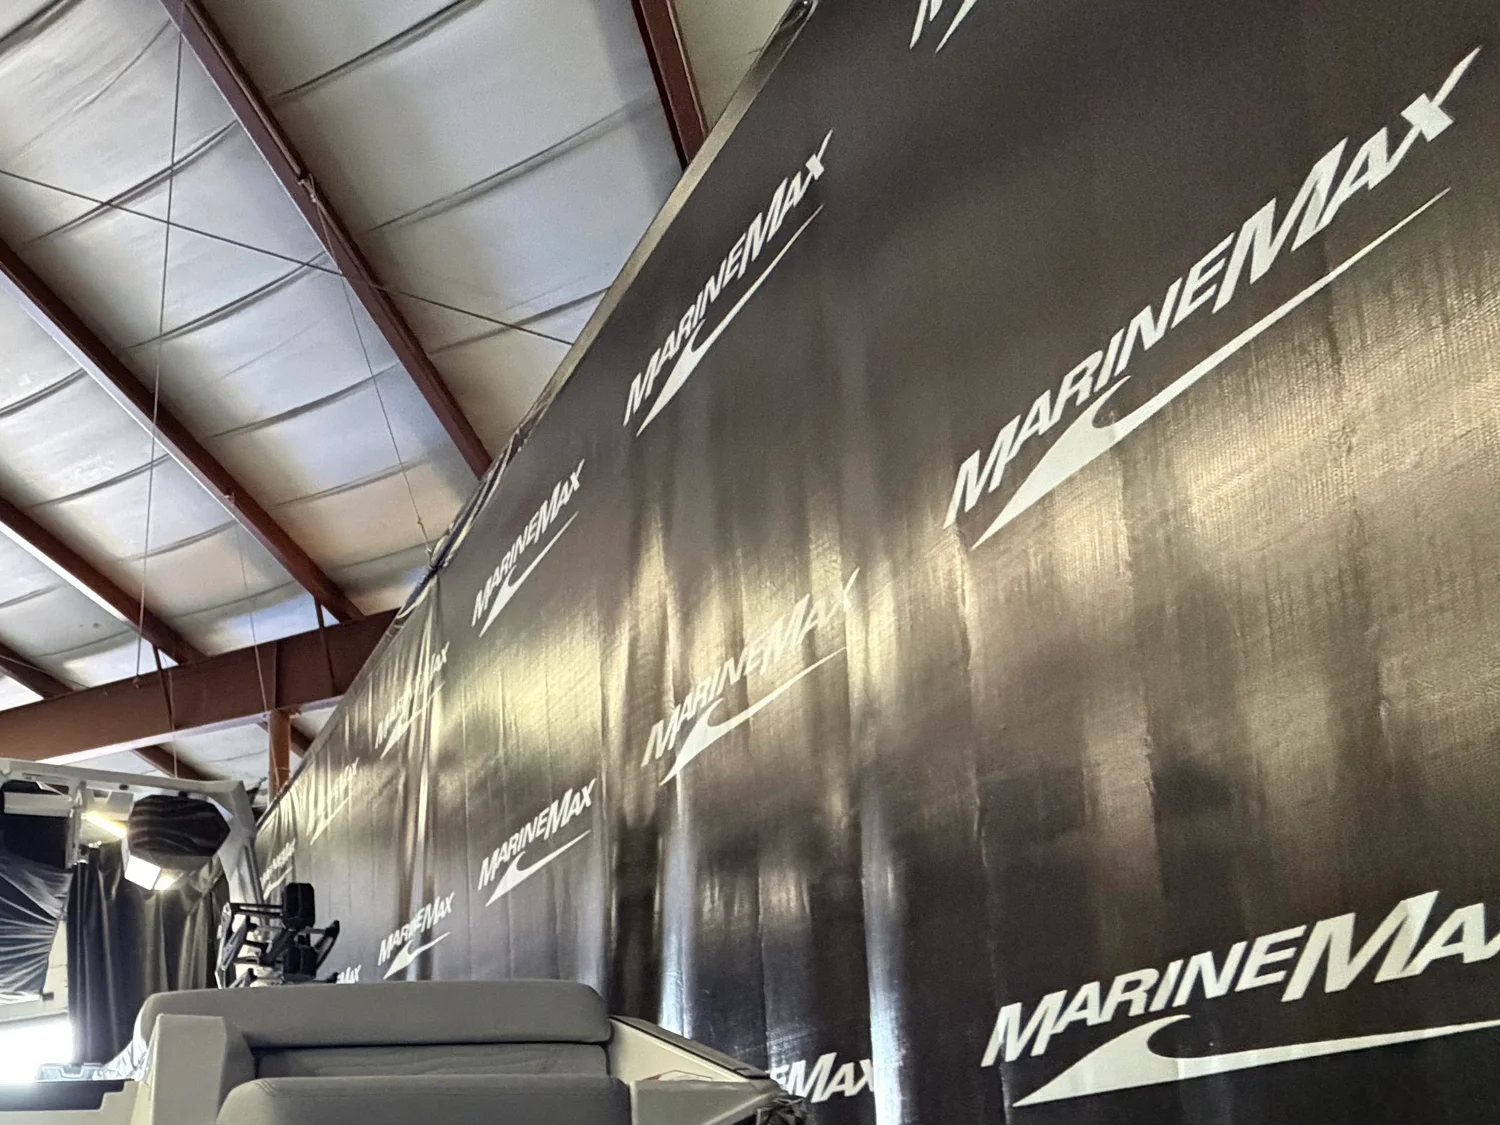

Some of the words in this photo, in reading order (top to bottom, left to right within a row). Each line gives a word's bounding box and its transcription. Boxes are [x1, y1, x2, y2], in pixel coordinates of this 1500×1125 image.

[623, 128, 834, 427] MARINEMAX
[944, 46, 1483, 530] MARINEMAX
[472, 458, 586, 628] MARINEMAX
[640, 567, 860, 768] MARINEMAX
[478, 777, 597, 891] MARINEMAX
[981, 889, 1500, 1067] MARINEMA
